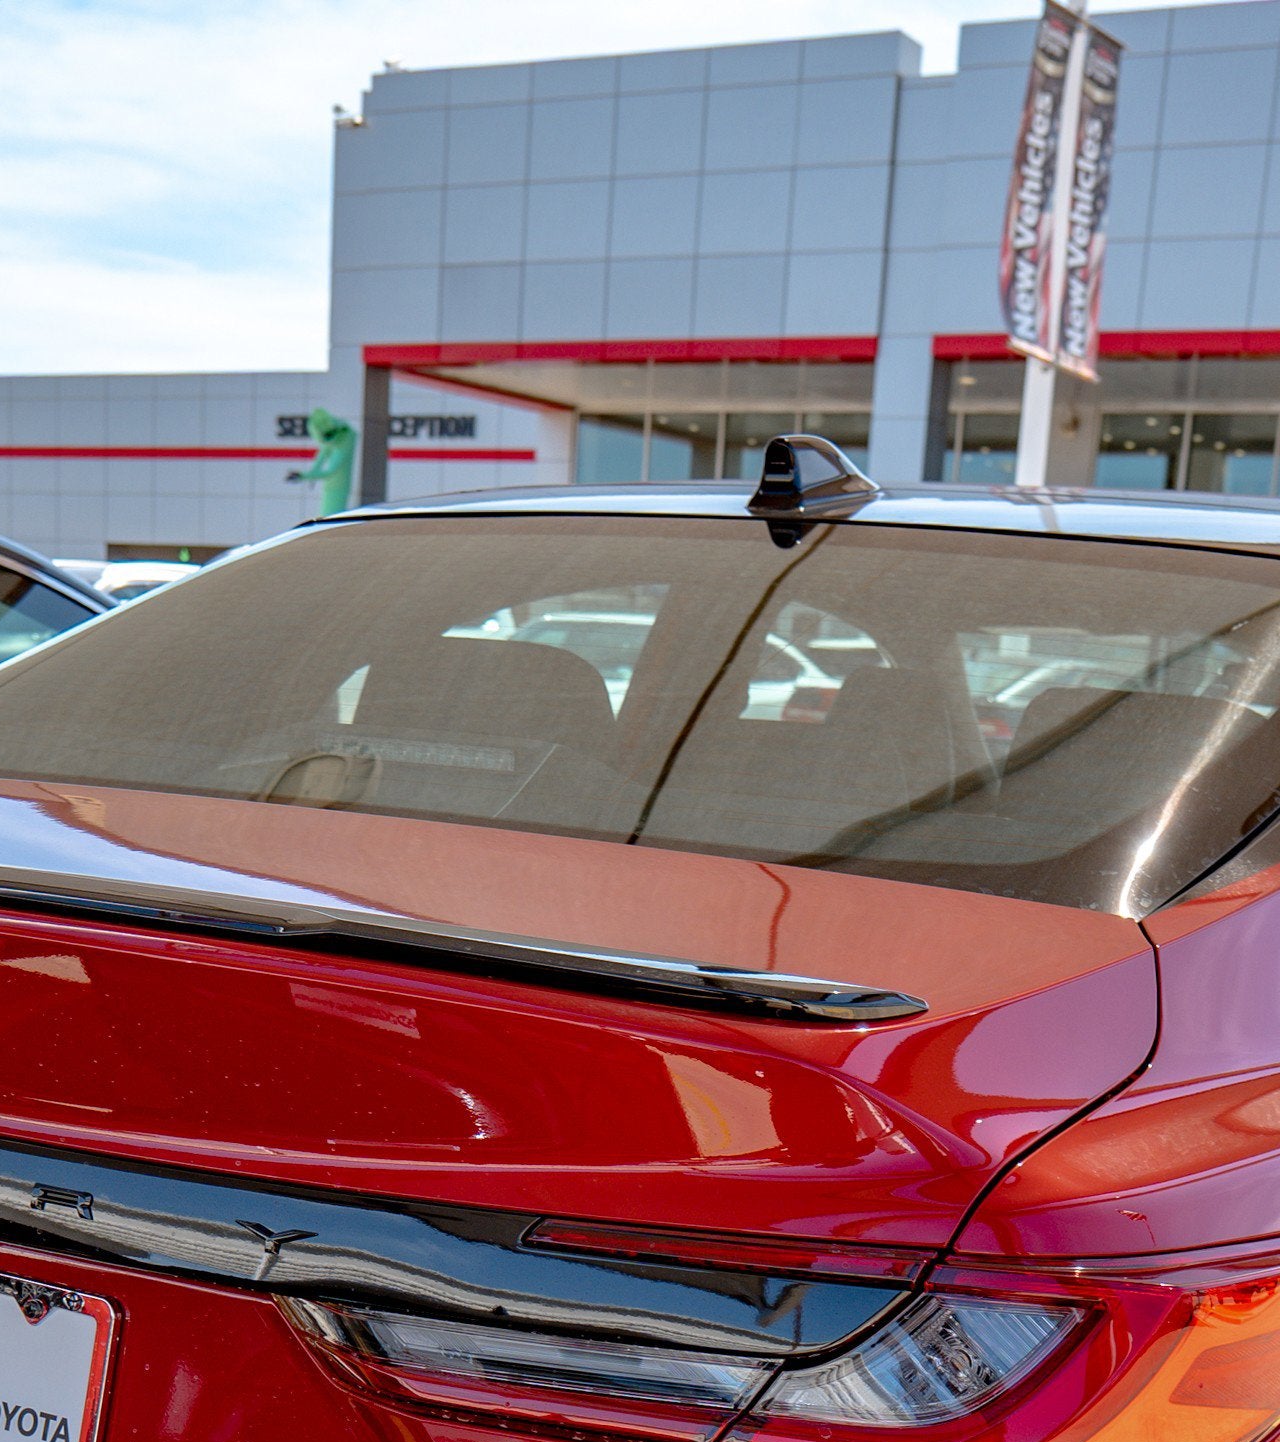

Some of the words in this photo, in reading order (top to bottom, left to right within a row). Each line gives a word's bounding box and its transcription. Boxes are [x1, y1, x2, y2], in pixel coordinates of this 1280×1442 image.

[1013, 91, 1054, 251] Vehicles
[1067, 117, 1104, 269] Vehicles
[1008, 259, 1039, 342] New
[1065, 276, 1088, 357] New
[389, 416, 475, 437] CEPTION
